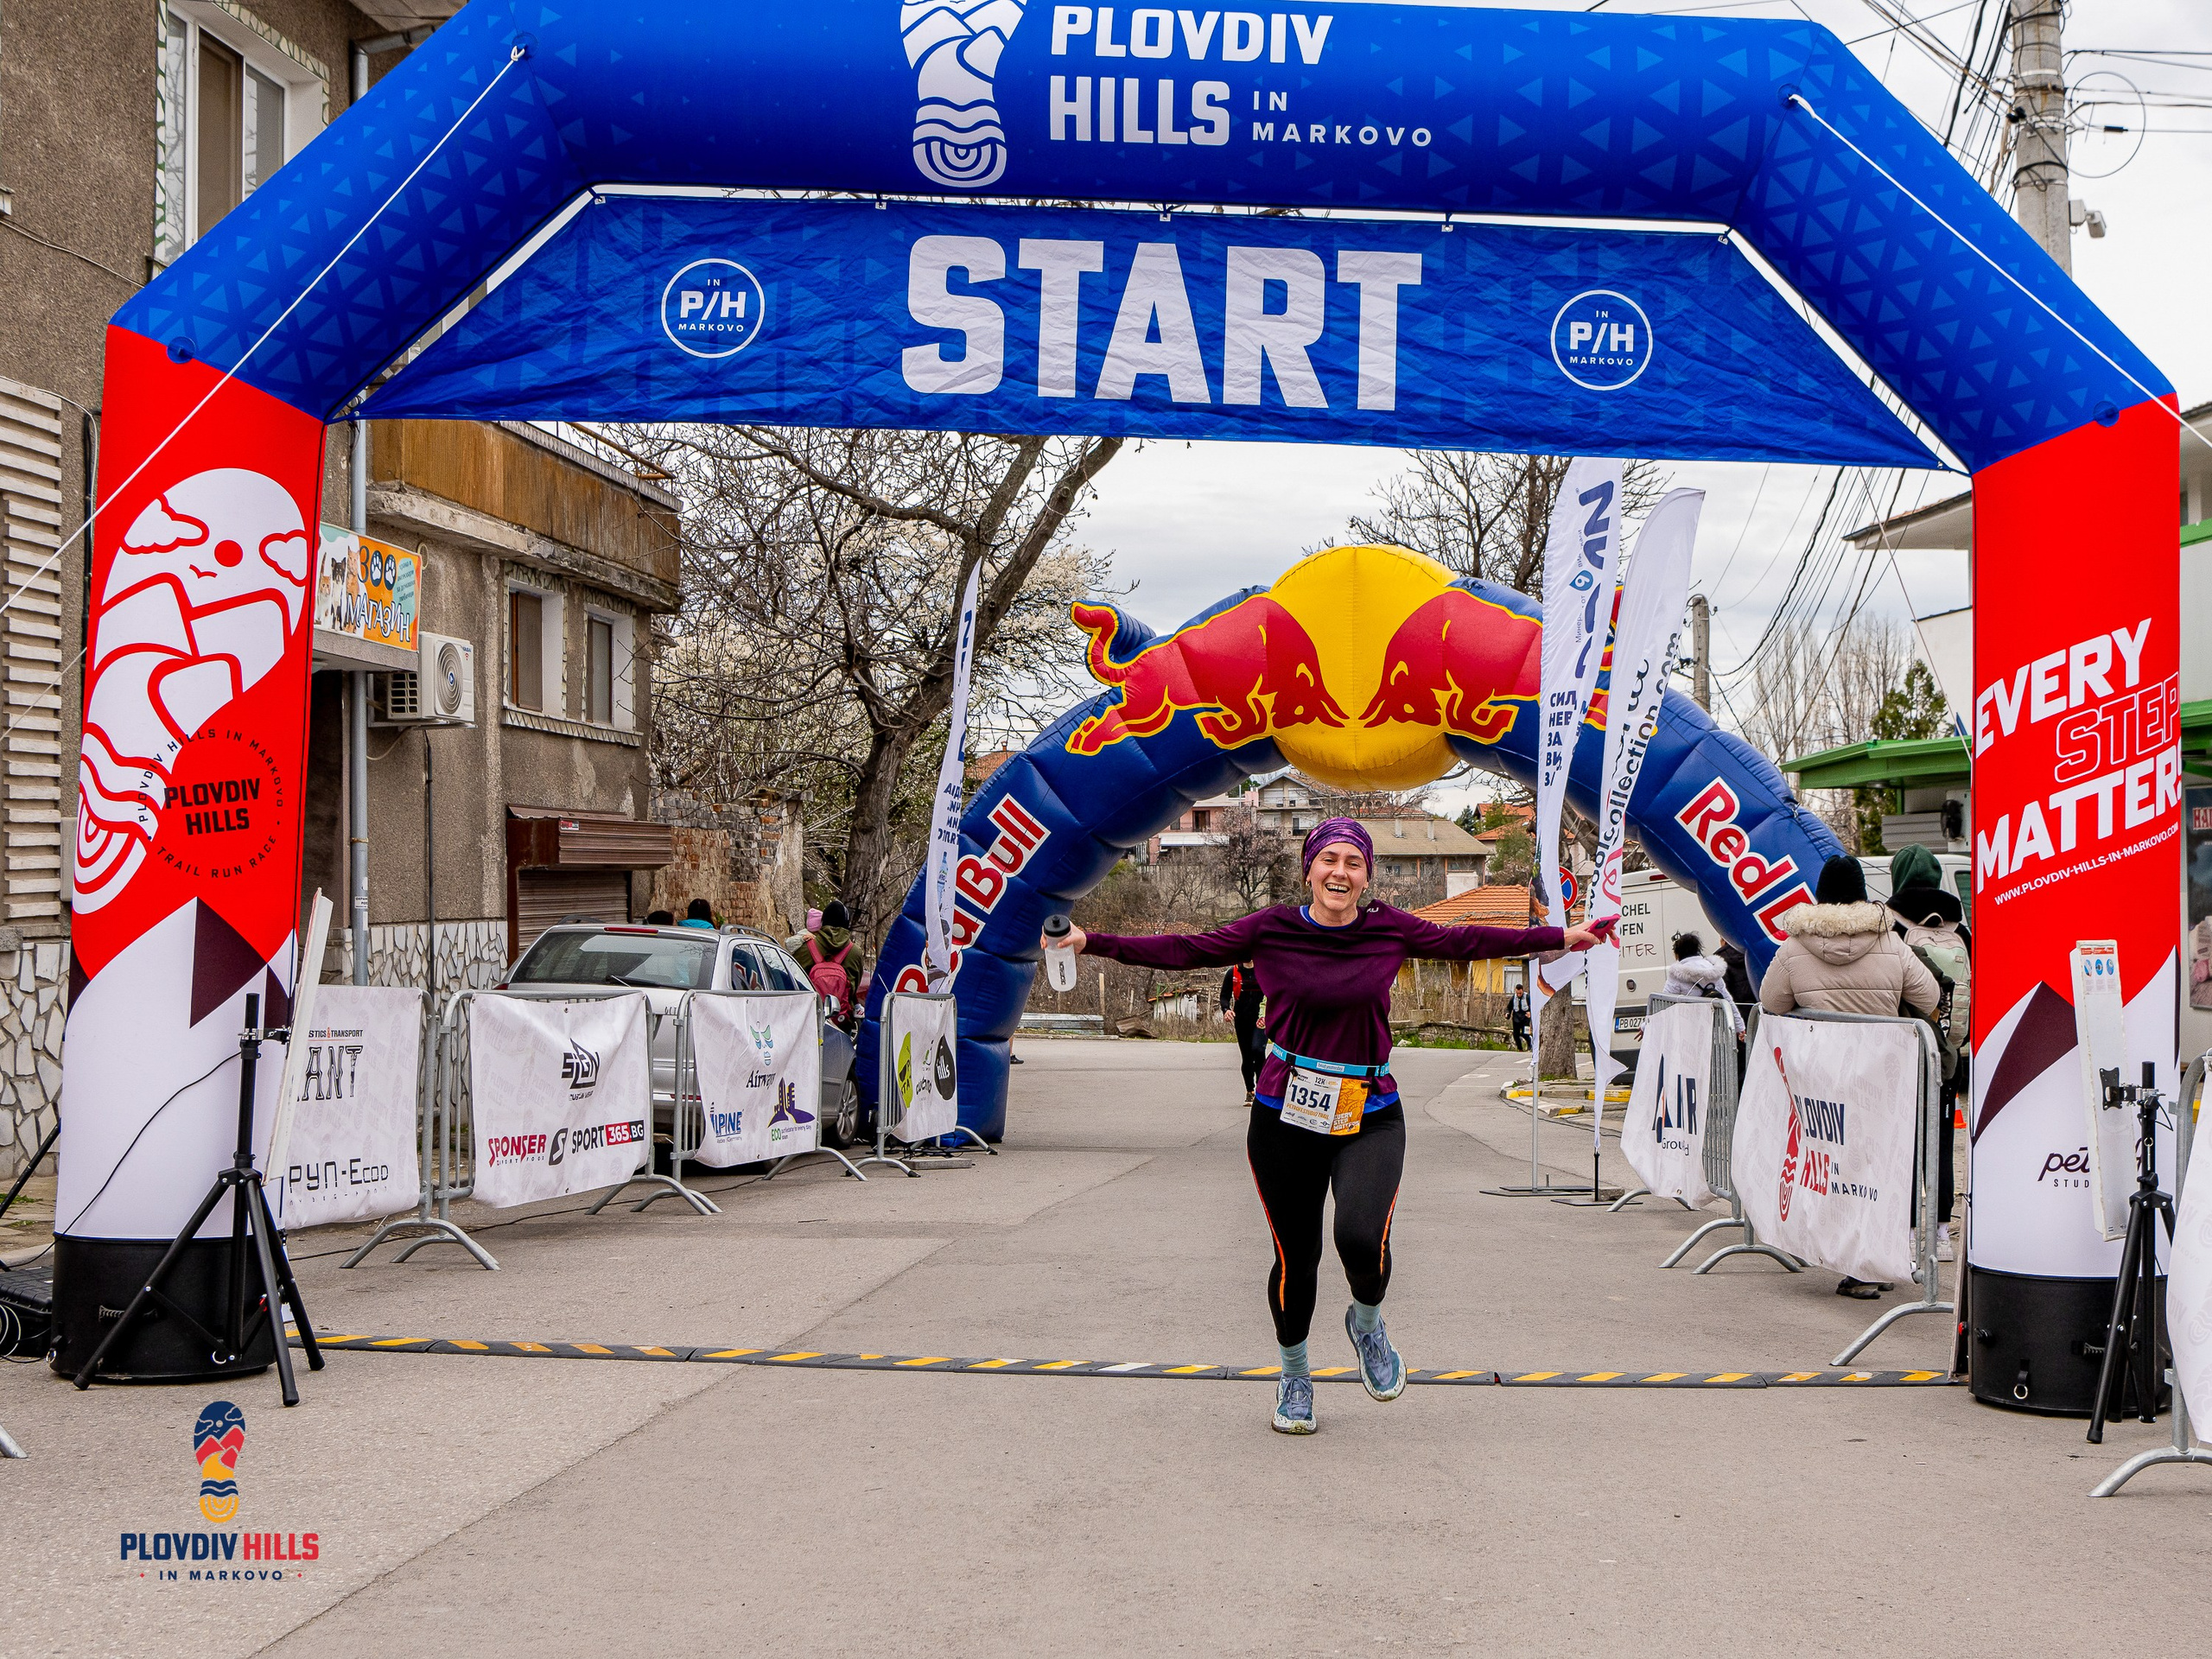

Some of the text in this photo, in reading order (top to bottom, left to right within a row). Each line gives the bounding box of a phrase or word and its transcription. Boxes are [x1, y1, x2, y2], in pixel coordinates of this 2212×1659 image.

[1051, 5, 1334, 65] PLOVDIV
[1049, 75, 1231, 147] HILLS
[1253, 90, 1288, 112] IN
[1252, 122, 1433, 148] MARKOVO
[680, 290, 747, 321] P/H
[1595, 310, 1609, 319] IN
[677, 323, 744, 333] MARKOVO
[901, 234, 1423, 412] START
[1569, 321, 1634, 354] P/H
[1569, 356, 1634, 366] MARKOVO
[346, 593, 410, 642] МАГАЗИН
[1975, 617, 2152, 760] EVERY
[2054, 671, 2180, 783] STEP
[137, 728, 283, 823] PLOVDIV HILLS IN MARKOVO
[163, 778, 260, 810] PLOVDIV
[185, 807, 250, 836] HILLS
[156, 835, 276, 878] TRAIL RUN RACE
[954, 796, 1046, 910] Bull
[1678, 780, 1795, 902] Red
[1994, 821, 2179, 906] WWW.PLOVDIV-HILLS-IN-MARKOVO.COM
[1620, 923, 1643, 935] FEN
[1619, 1019, 1629, 1028] PB
[301, 1046, 364, 1102] ANT
[1290, 1084, 1332, 1112] 1354
[1651, 1052, 1697, 1135] AIR
[487, 1134, 547, 1167] SPONSER
[772, 1128, 782, 1141] ECO
[1831, 1161, 1840, 1175] IN
[2053, 1179, 2090, 1188] STUD
[1831, 1181, 1878, 1202] MARKOVO
